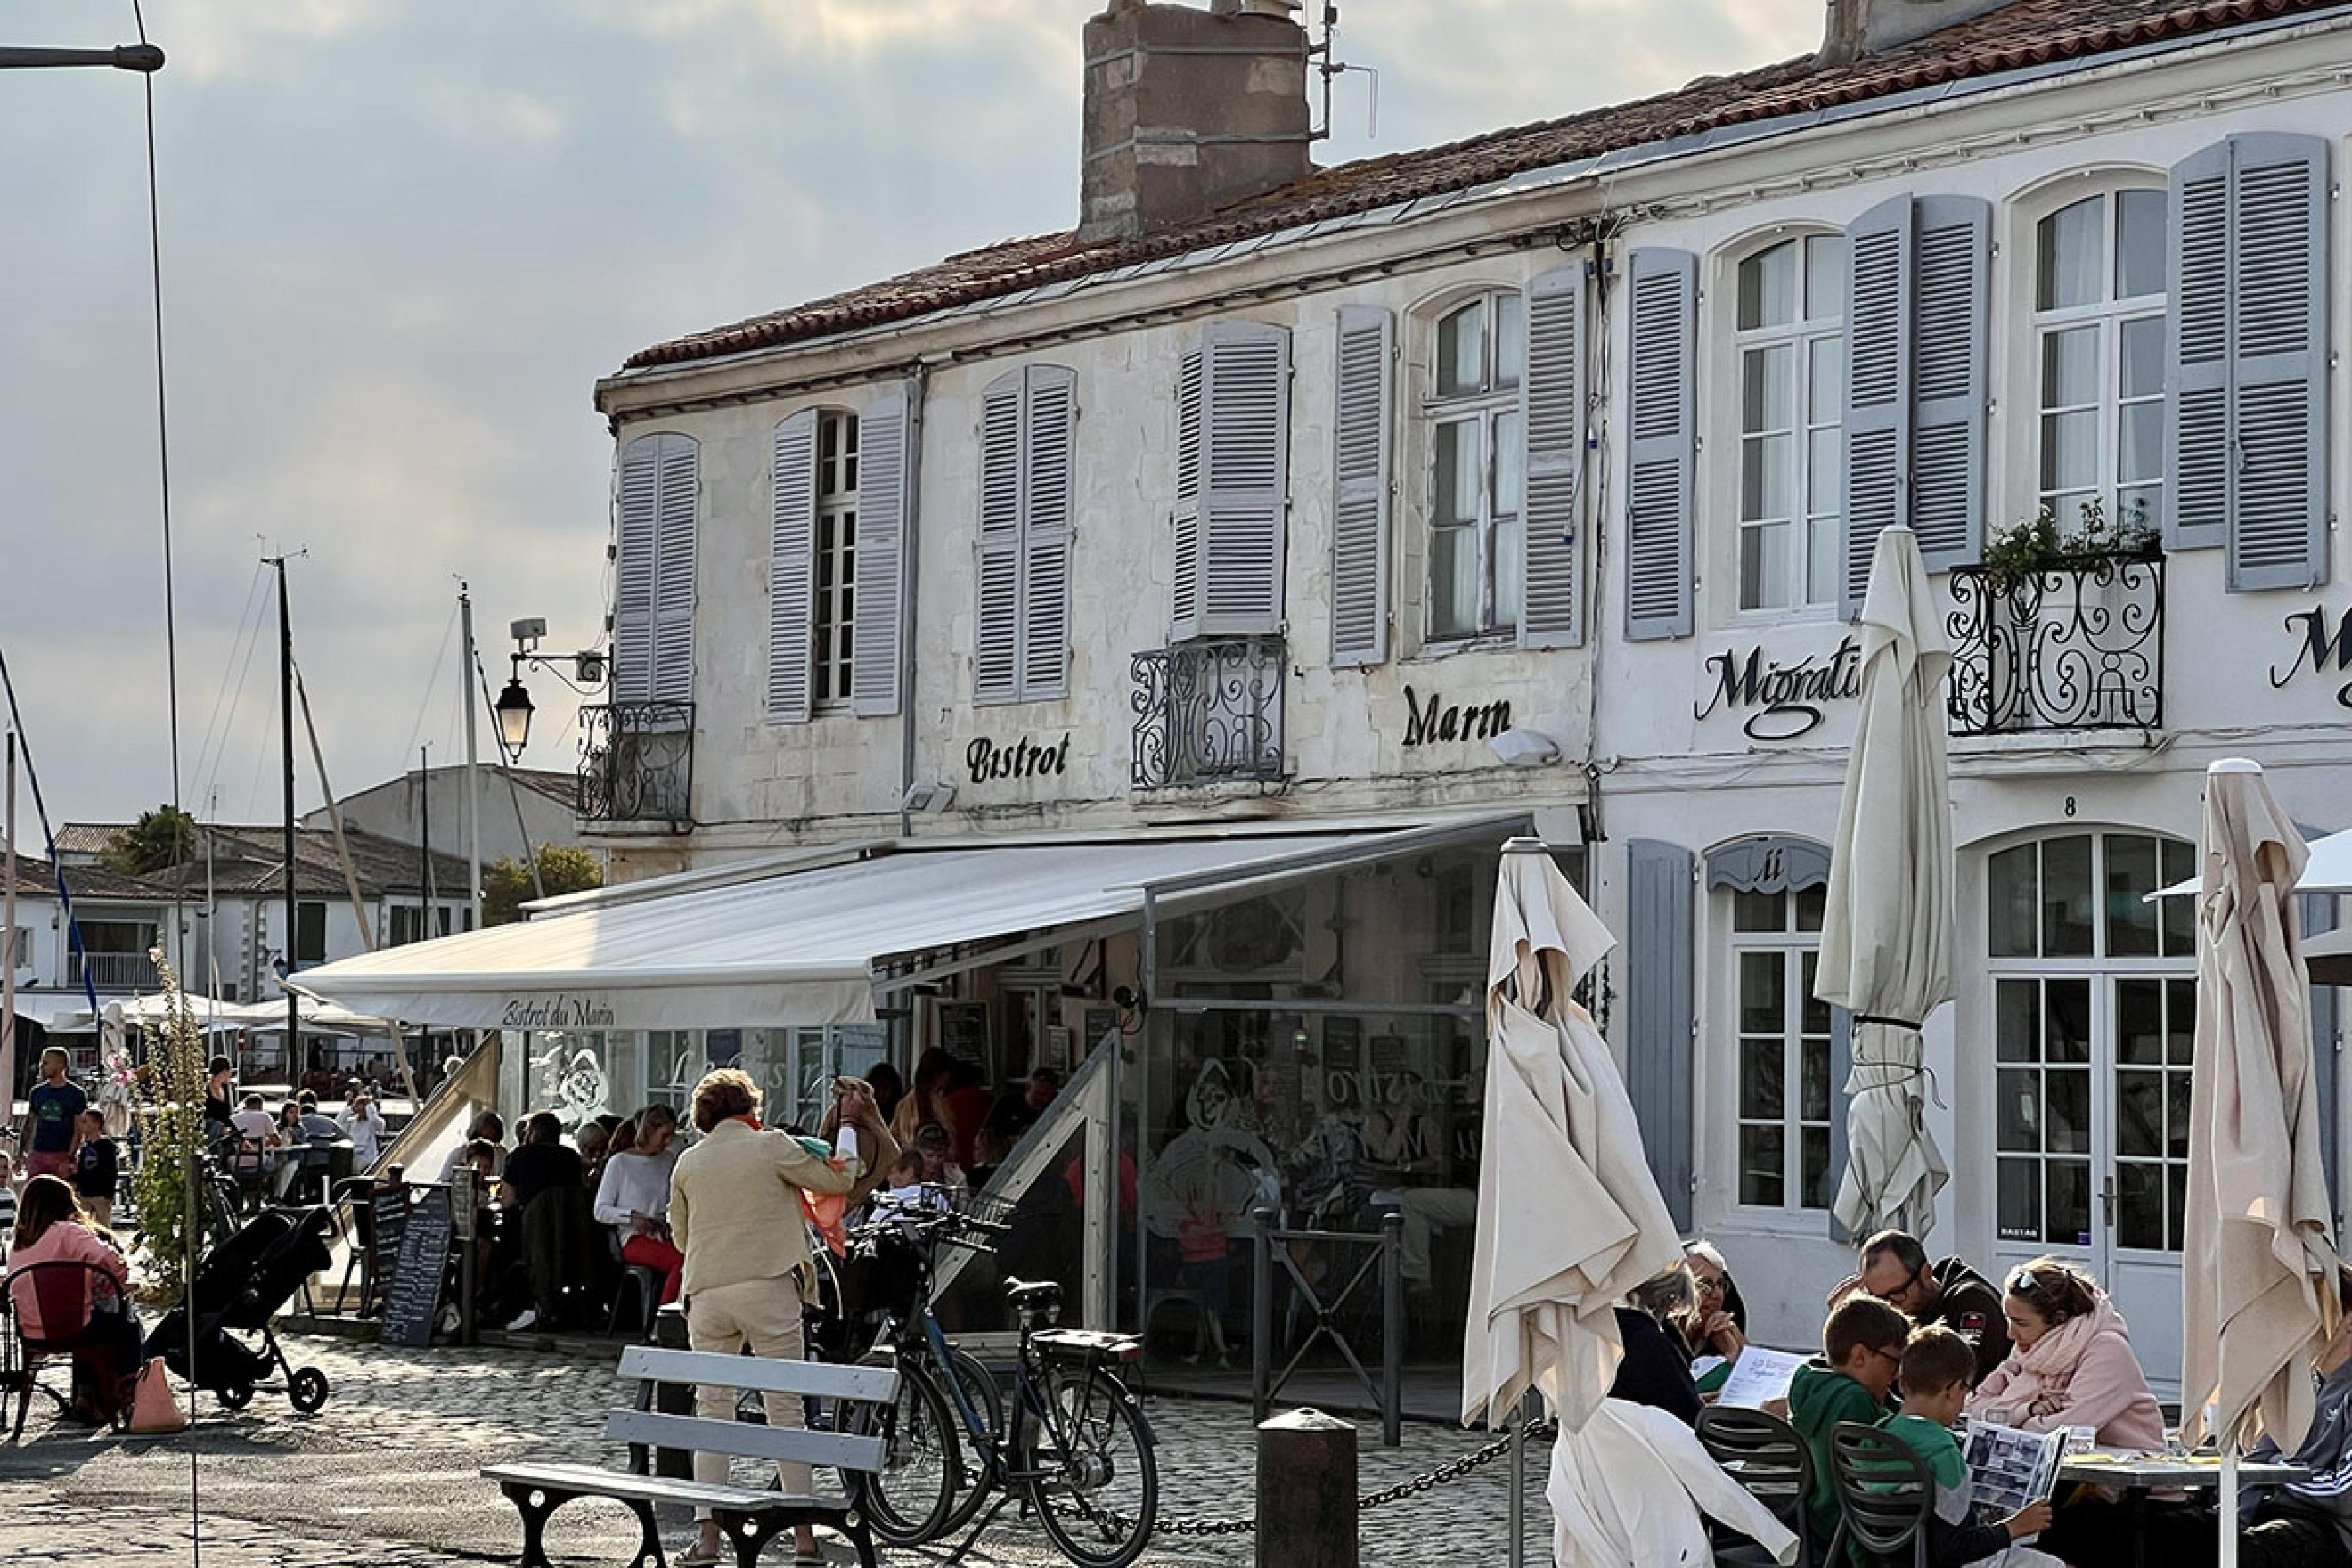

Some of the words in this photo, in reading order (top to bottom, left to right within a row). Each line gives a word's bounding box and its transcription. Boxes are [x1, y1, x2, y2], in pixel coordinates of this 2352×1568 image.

[1694, 635, 1861, 740] Migrati
[966, 733, 1071, 784] Bistrot
[1401, 684, 1512, 745] Marin
[2064, 795, 2077, 818] 8
[501, 998, 550, 1026] Bistrot
[551, 993, 569, 1026] du
[573, 998, 614, 1026] Marin
